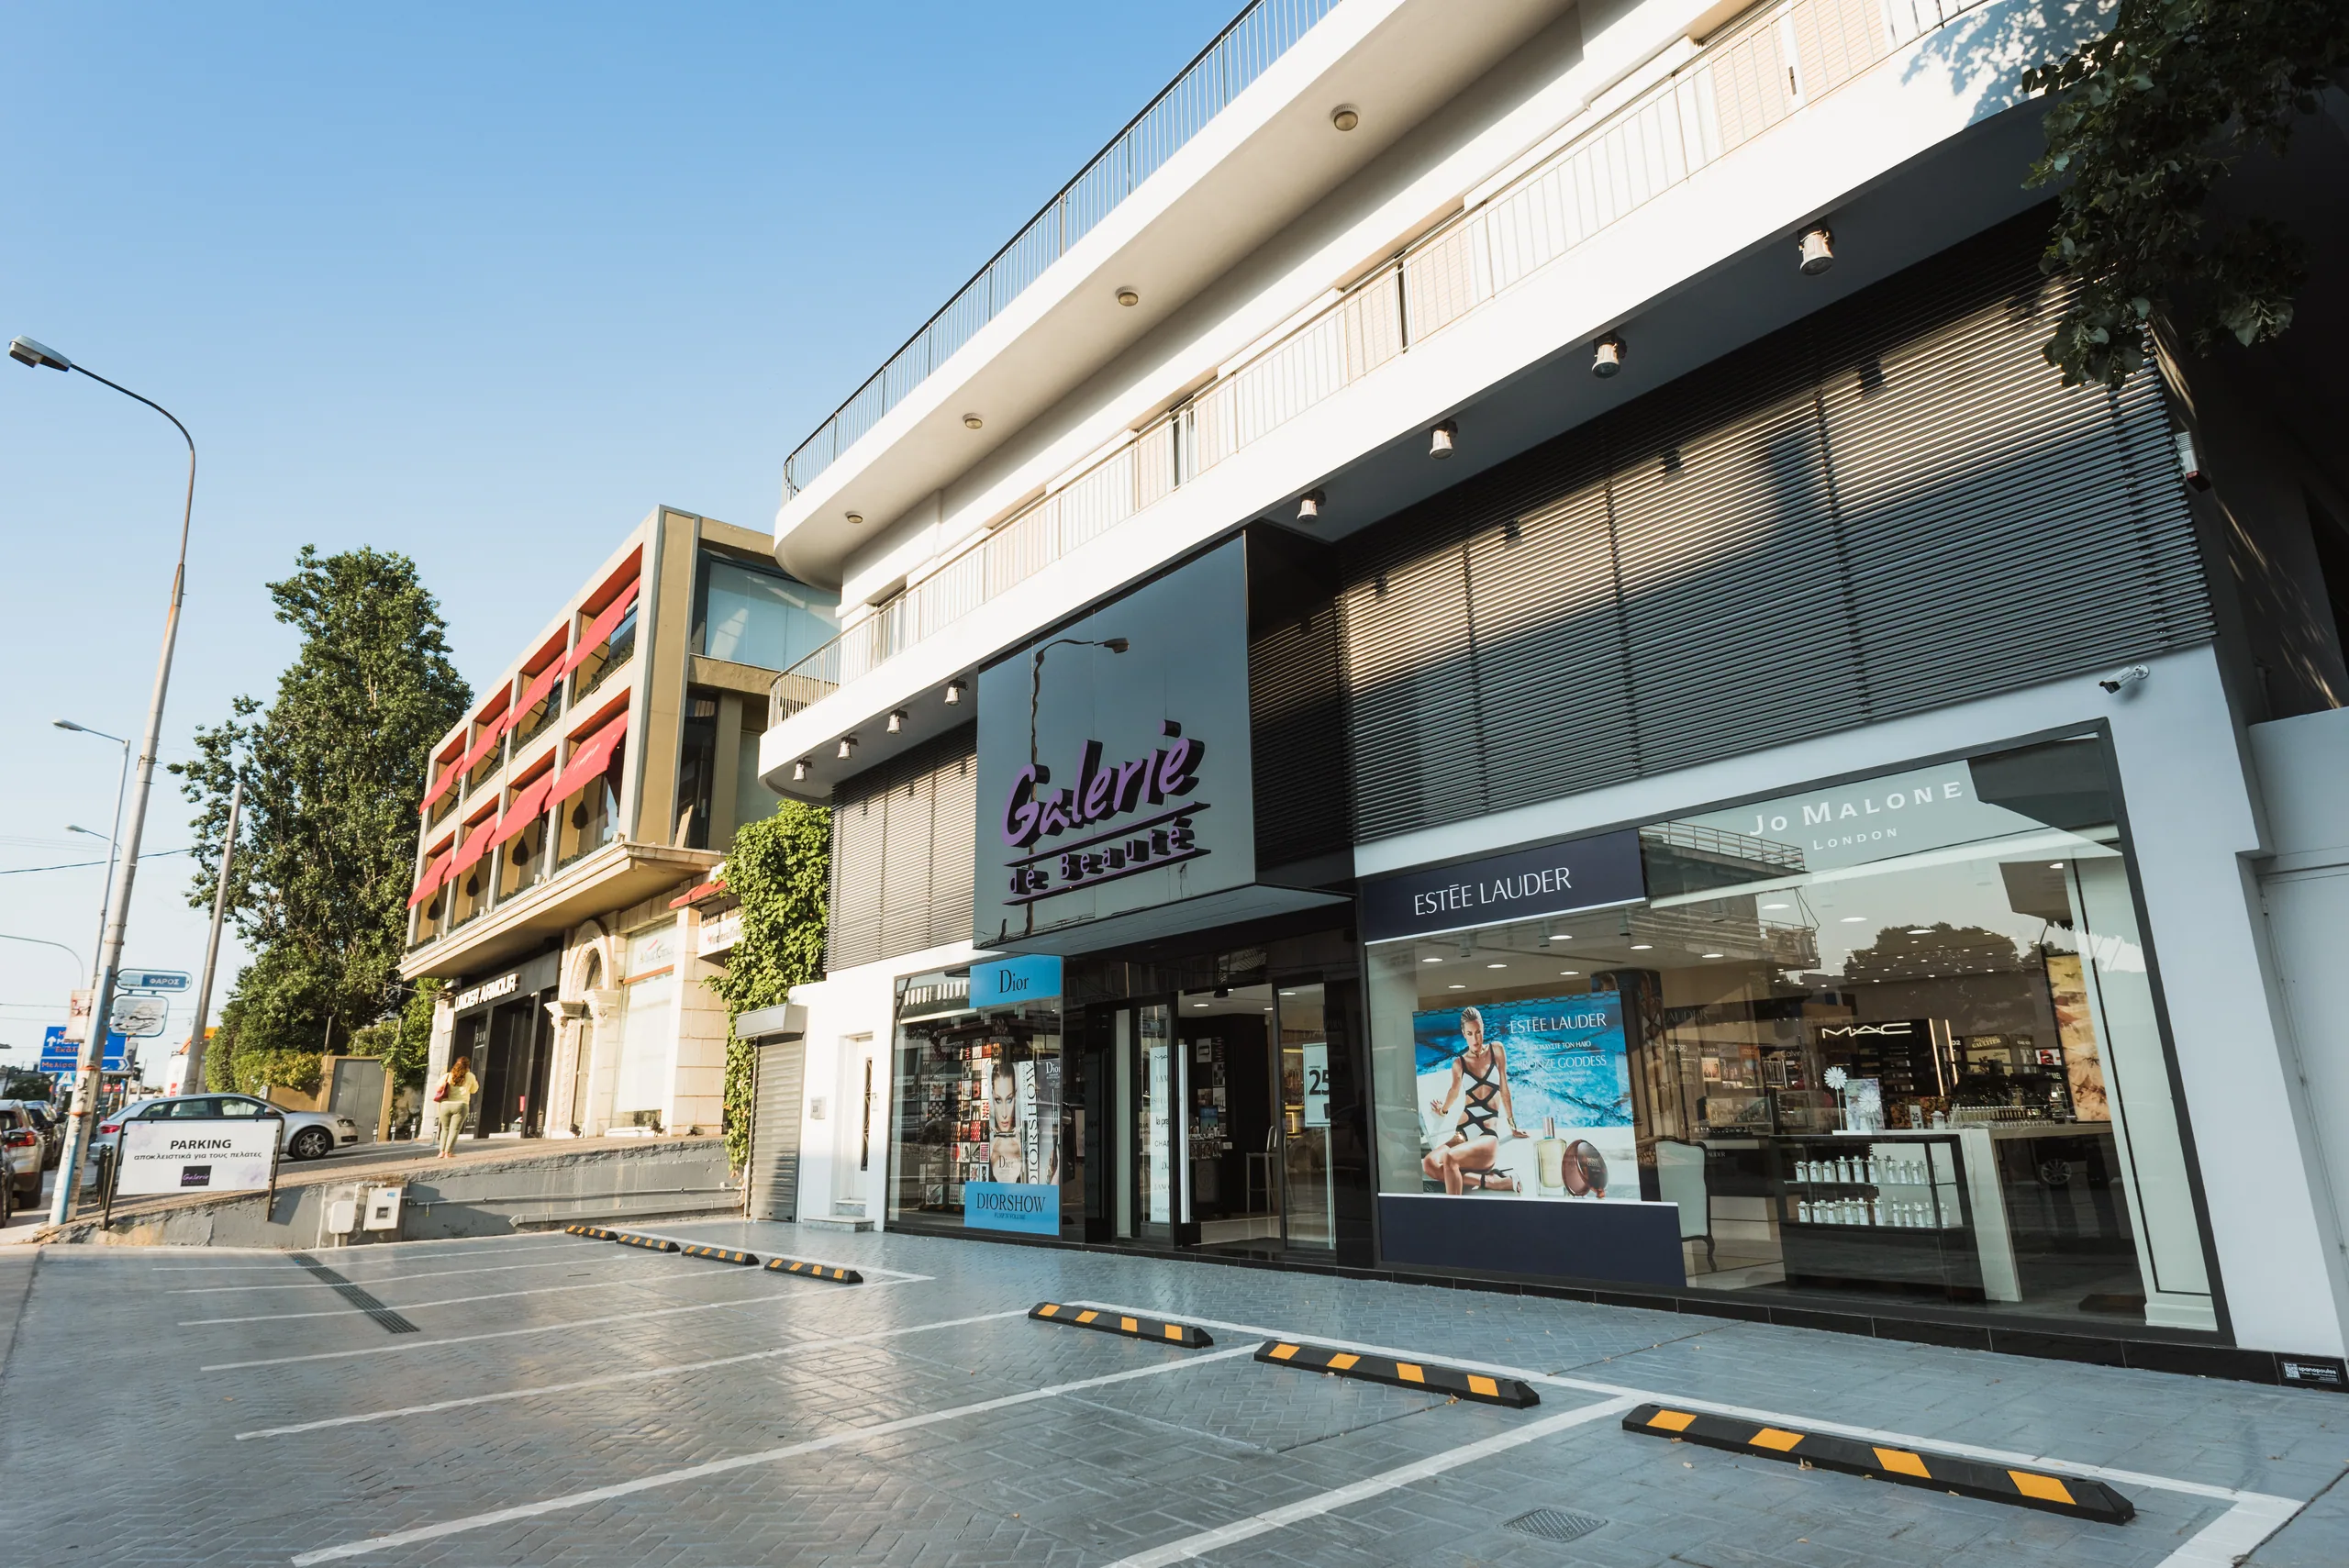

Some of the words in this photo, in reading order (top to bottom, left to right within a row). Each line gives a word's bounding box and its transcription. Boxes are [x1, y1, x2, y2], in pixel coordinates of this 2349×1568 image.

[1002, 719, 1202, 848] Galerie
[1812, 827, 1898, 851] LONDON
[1010, 868, 1048, 895] de
[1061, 817, 1195, 880] Beauté
[1479, 866, 1572, 905] LAUDER
[998, 969, 1030, 994] Dior
[454, 987, 480, 1013] UNDER
[479, 973, 517, 1004] ARMOUR
[1551, 1012, 1607, 1030] LAUDER
[1517, 1058, 1556, 1070] BRONZE
[1557, 1054, 1607, 1068] GODDESS
[1912, 1113, 1920, 1121] 25
[170, 1139, 232, 1150] PARKING
[134, 1152, 191, 1161] αποκλειστικά
[194, 1152, 206, 1161] για
[230, 1151, 262, 1159] πελάτες
[998, 1155, 1014, 1169] Dior
[975, 1192, 1046, 1214] DIORSHOW
